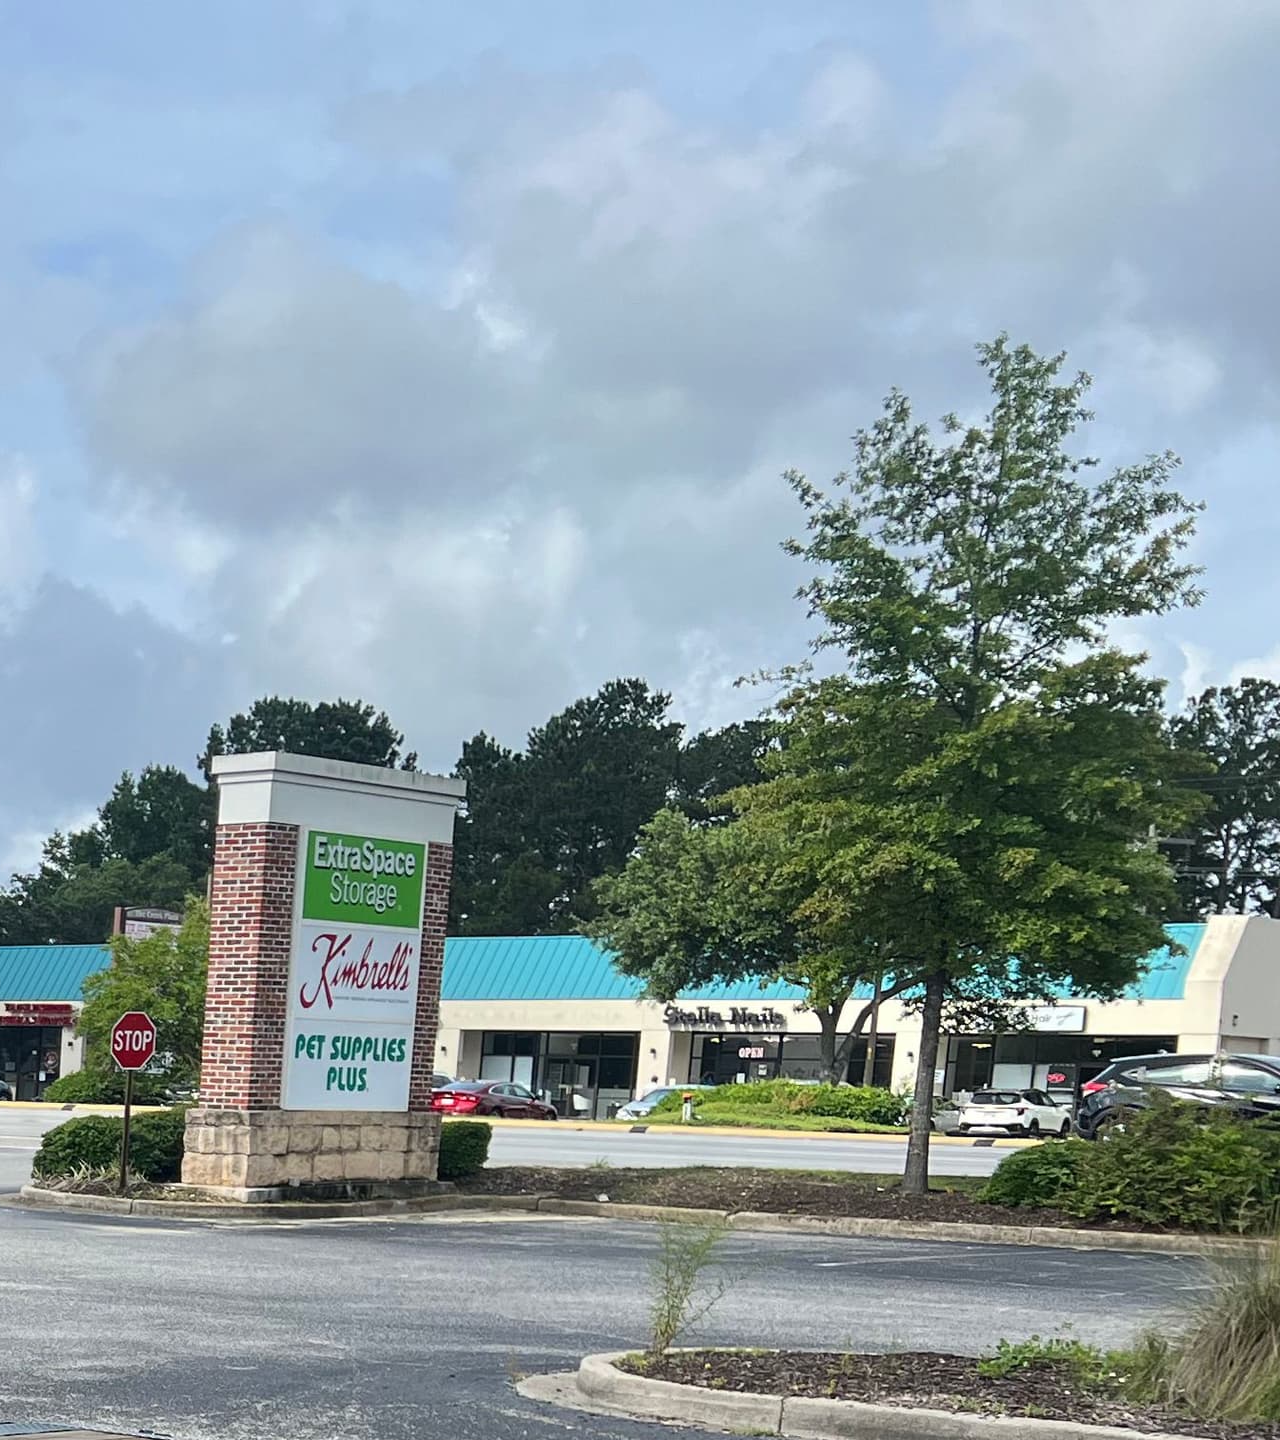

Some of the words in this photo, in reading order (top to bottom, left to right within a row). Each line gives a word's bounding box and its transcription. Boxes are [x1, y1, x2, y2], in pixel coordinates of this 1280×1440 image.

[330, 872, 398, 913] Storage
[663, 1003, 722, 1026] Stella
[726, 1006, 786, 1026] Nails
[114, 1030, 153, 1052] STOP
[295, 1033, 326, 1060] PET
[330, 1036, 406, 1062] SUPPLIES
[738, 1047, 764, 1059] OPEN
[326, 1066, 367, 1092] PLUS
